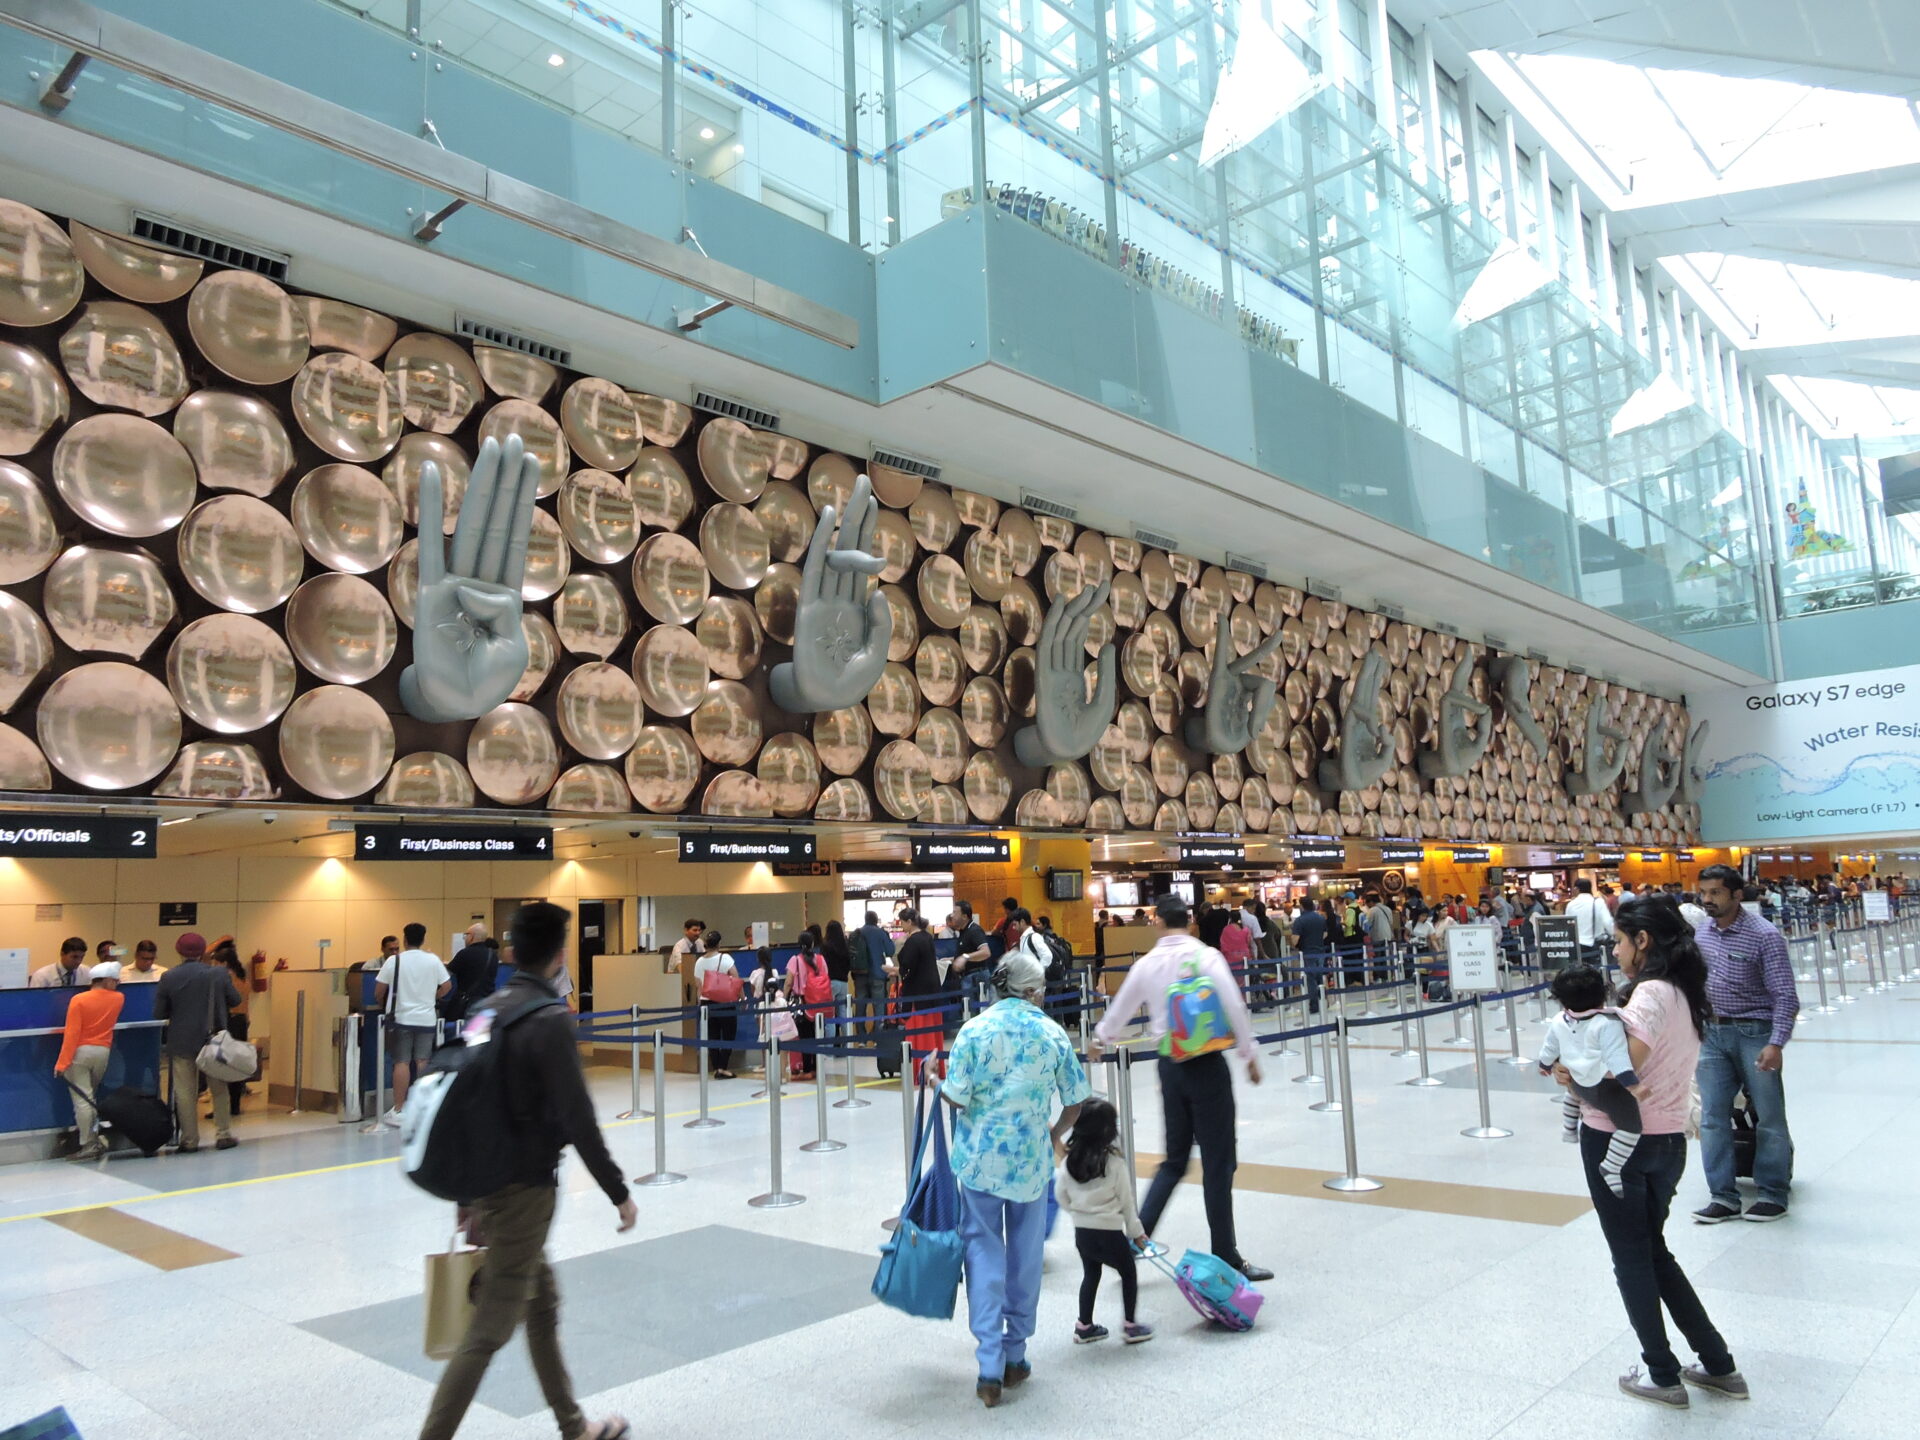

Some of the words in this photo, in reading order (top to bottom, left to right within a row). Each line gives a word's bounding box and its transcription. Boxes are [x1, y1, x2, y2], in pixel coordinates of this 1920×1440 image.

[1746, 690, 1822, 711] Galaxy
[1827, 684, 1850, 701] S7
[1855, 682, 1905, 699] edge
[1804, 724, 1869, 751] Water
[1876, 721, 1920, 738] Resi
[1757, 809, 1814, 822] Low-Light
[1817, 806, 1868, 818] Camera
[131, 830, 147, 846] 2
[364, 835, 376, 849] 3
[536, 837, 546, 850] 4
[400, 838, 482, 852] First/Business
[484, 839, 515, 850] Class
[686, 841, 694, 853] 5
[710, 843, 767, 855] First/Business
[768, 844, 790, 854] Class
[804, 843, 812, 854] 6
[915, 844, 922, 855] 7
[929, 845, 947, 854] Indian
[948, 845, 973, 855] Passport
[974, 845, 995, 854] Holders
[1001, 845, 1008, 855] 8
[1172, 870, 1191, 881] Dior
[871, 889, 909, 898] CHANEL
